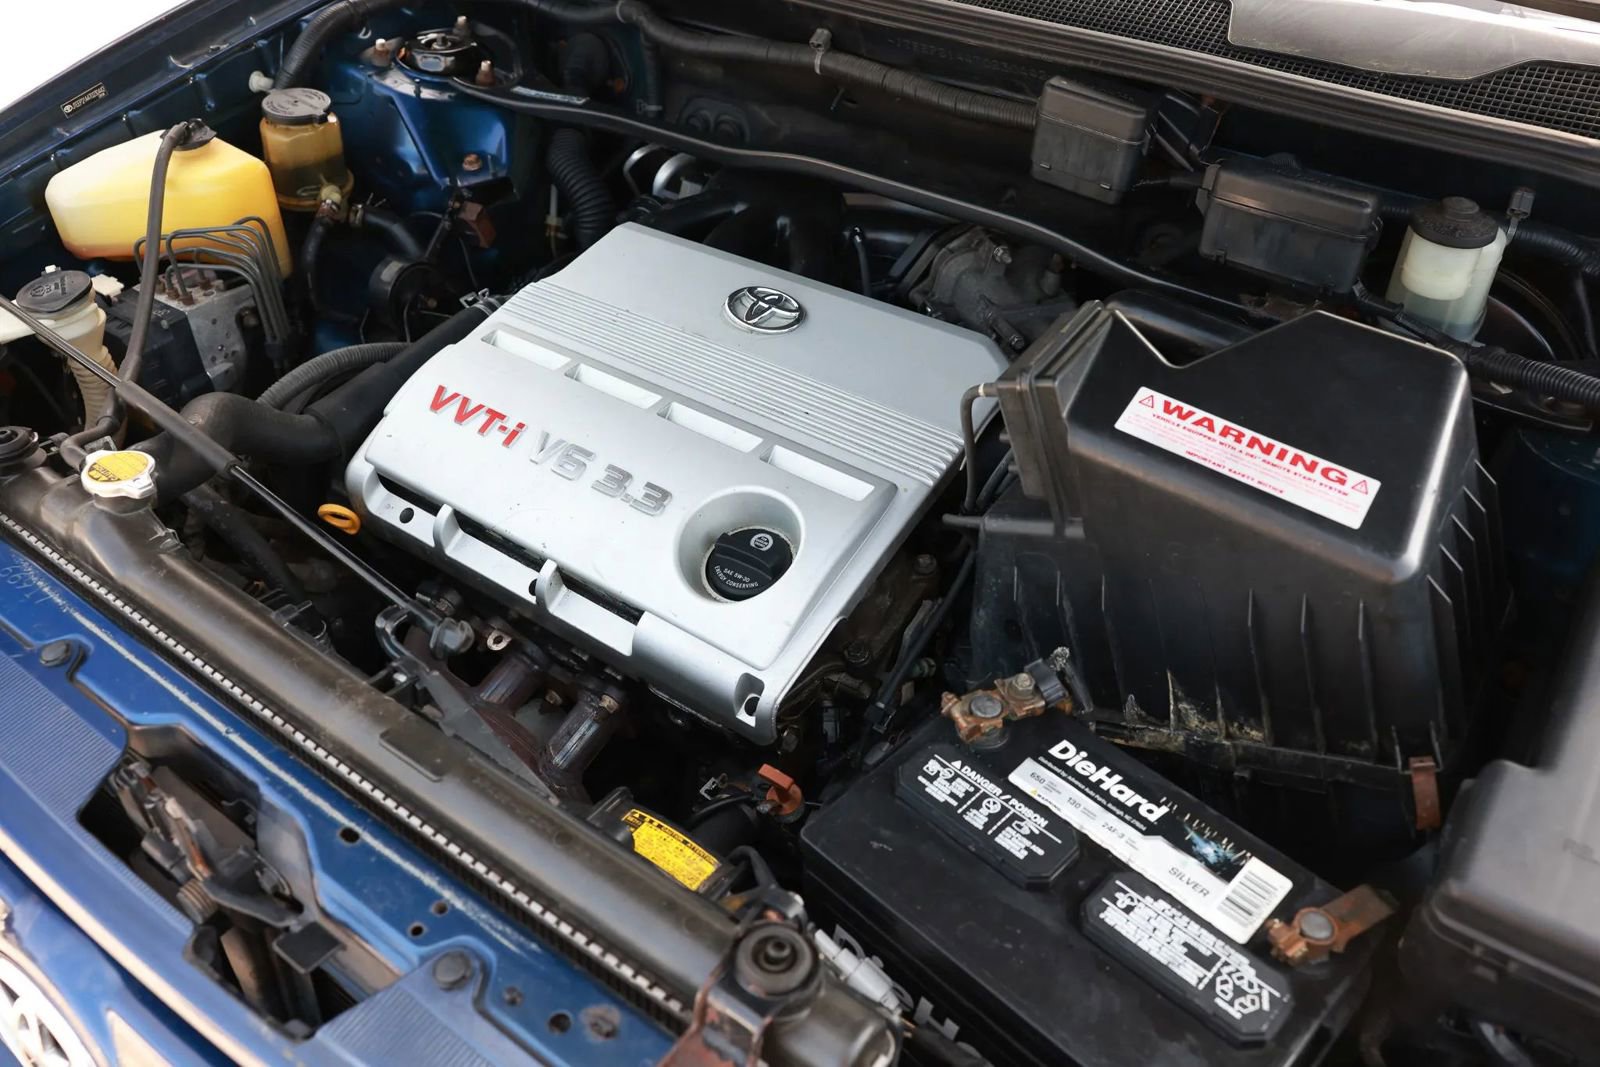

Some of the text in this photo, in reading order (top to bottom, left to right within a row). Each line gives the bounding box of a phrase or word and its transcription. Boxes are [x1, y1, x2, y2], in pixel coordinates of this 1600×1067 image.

[429, 384, 673, 516] VVT-i V6 3.3
[1162, 399, 1349, 487] WARNING
[1182, 426, 1217, 442] EQUIPPED
[1218, 441, 1237, 451] WITH
[1261, 459, 1291, 473] REMOTE
[1293, 471, 1316, 483] START
[1319, 482, 1349, 496] SYSTEM
[1185, 450, 1226, 469] IMPORTANT
[1228, 468, 1255, 481] SAFETY
[714, 565, 759, 589] ENERGY CONSERVING
[723, 567, 750, 583] SAE 5W-30
[960, 765, 1004, 797] DANGER
[1008, 798, 1049, 828] POISON
[1029, 772, 1046, 784] 650
[1067, 796, 1082, 809] 130
[1047, 738, 1170, 824] DieHard
[1168, 865, 1210, 899] SILVER
